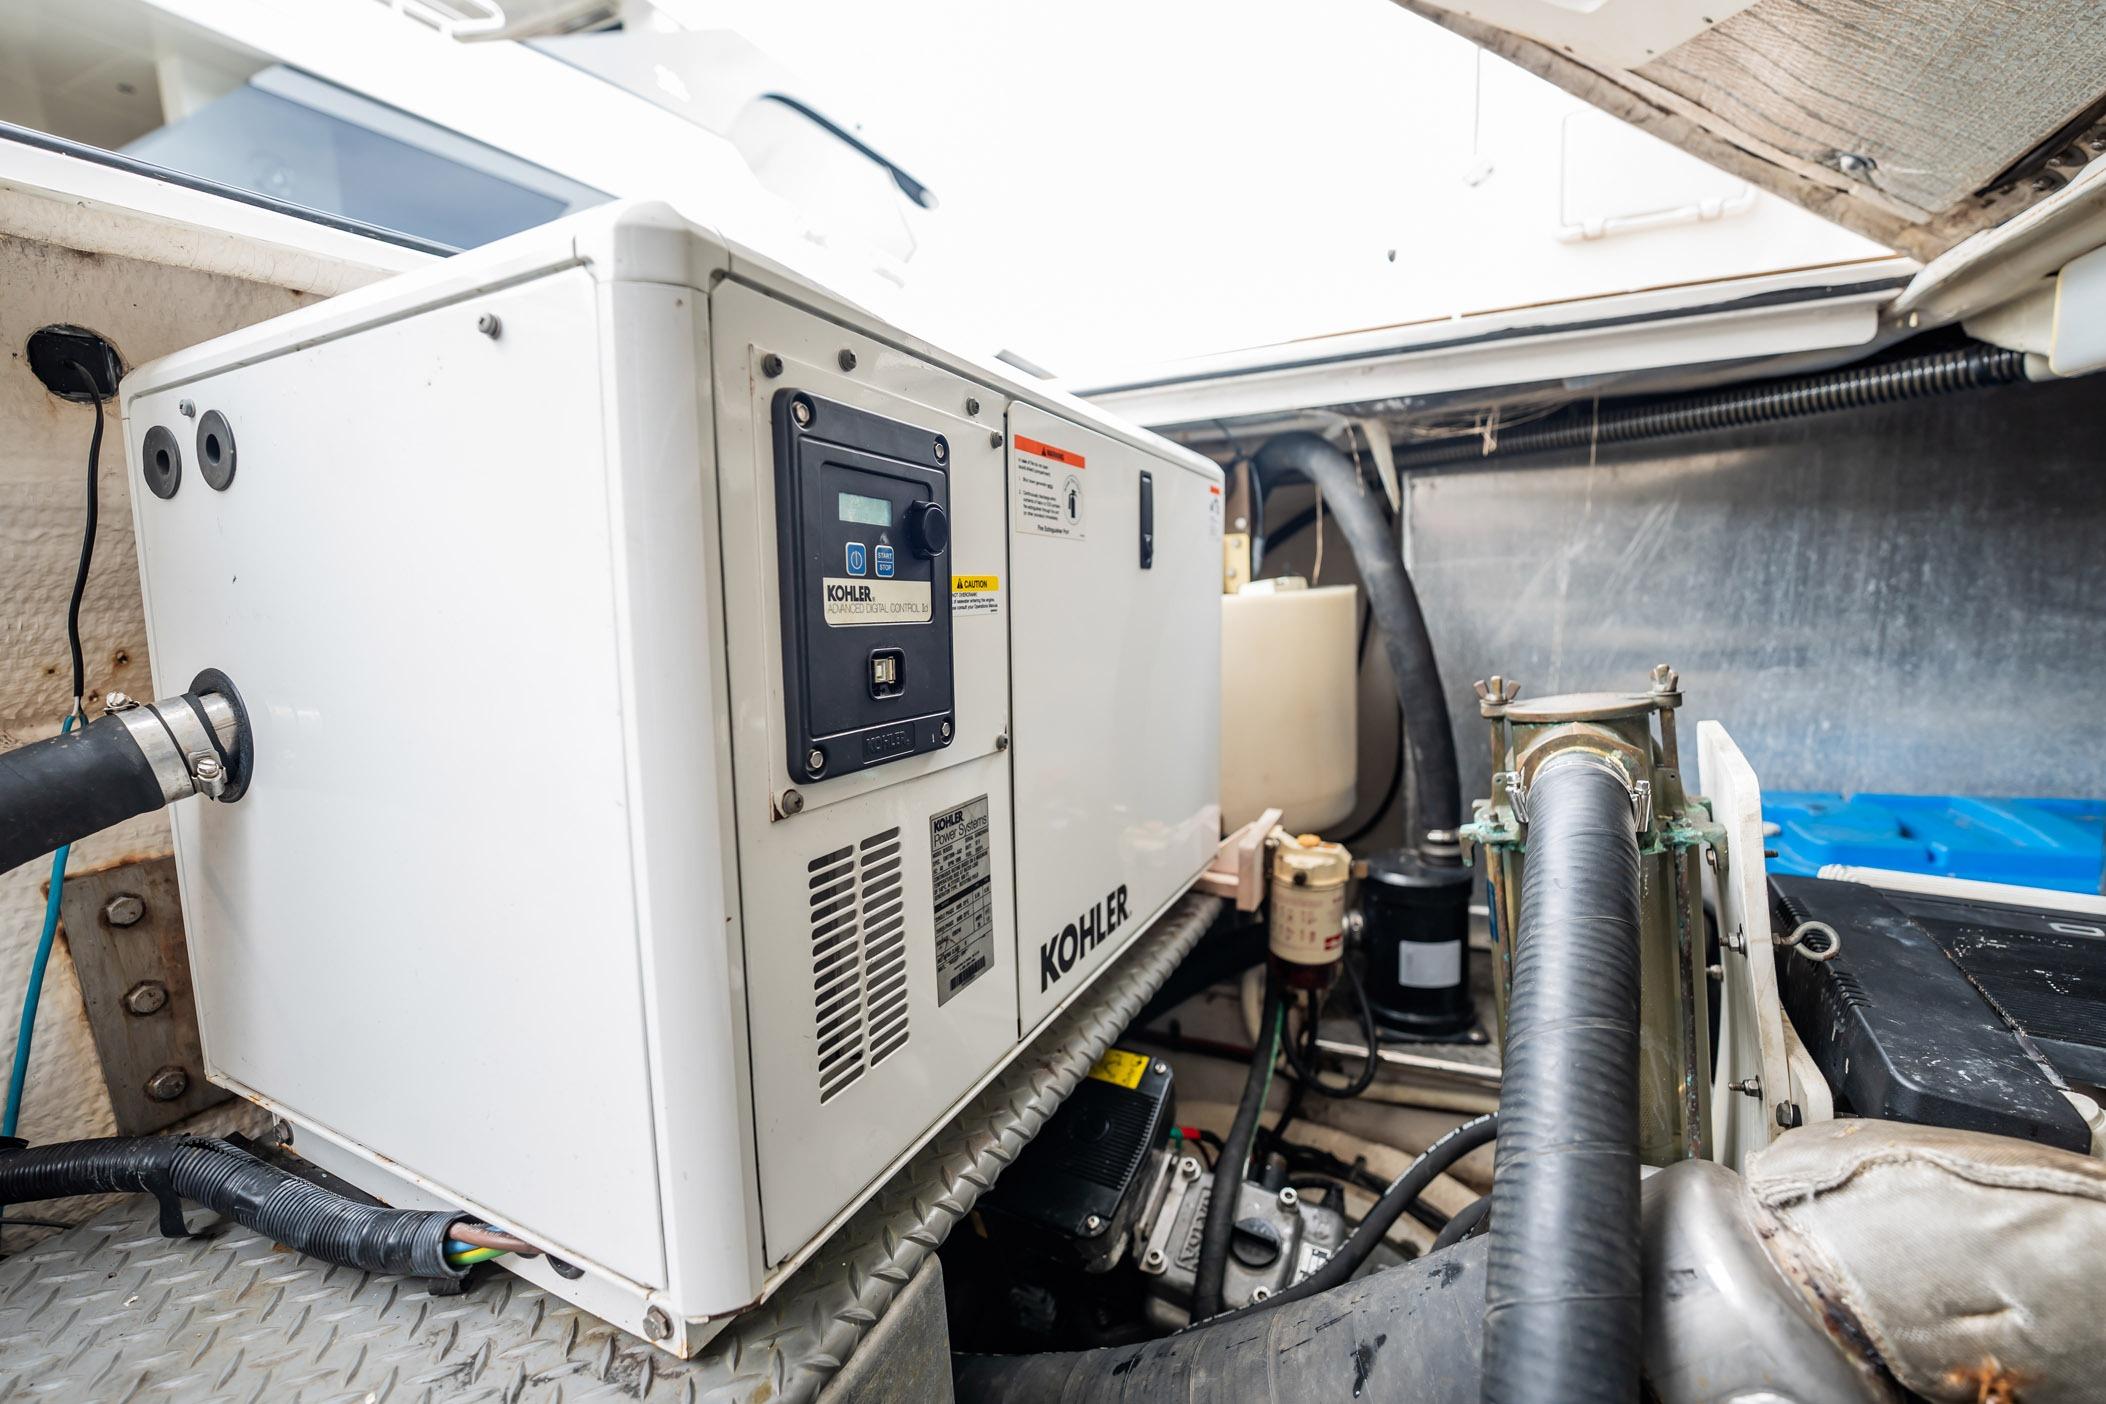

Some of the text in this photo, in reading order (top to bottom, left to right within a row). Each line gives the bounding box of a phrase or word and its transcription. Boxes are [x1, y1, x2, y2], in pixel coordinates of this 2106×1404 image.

[827, 585, 872, 602] KOHLER
[964, 580, 987, 588] CAUTION
[828, 603, 864, 614] ADVANCED
[866, 603, 888, 613] DIGITAL
[890, 603, 920, 613] CONTROL
[933, 811, 965, 833] KOHLER
[934, 829, 957, 848] Power
[958, 815, 987, 837] Systems
[1041, 884, 1129, 994] KOHLER
